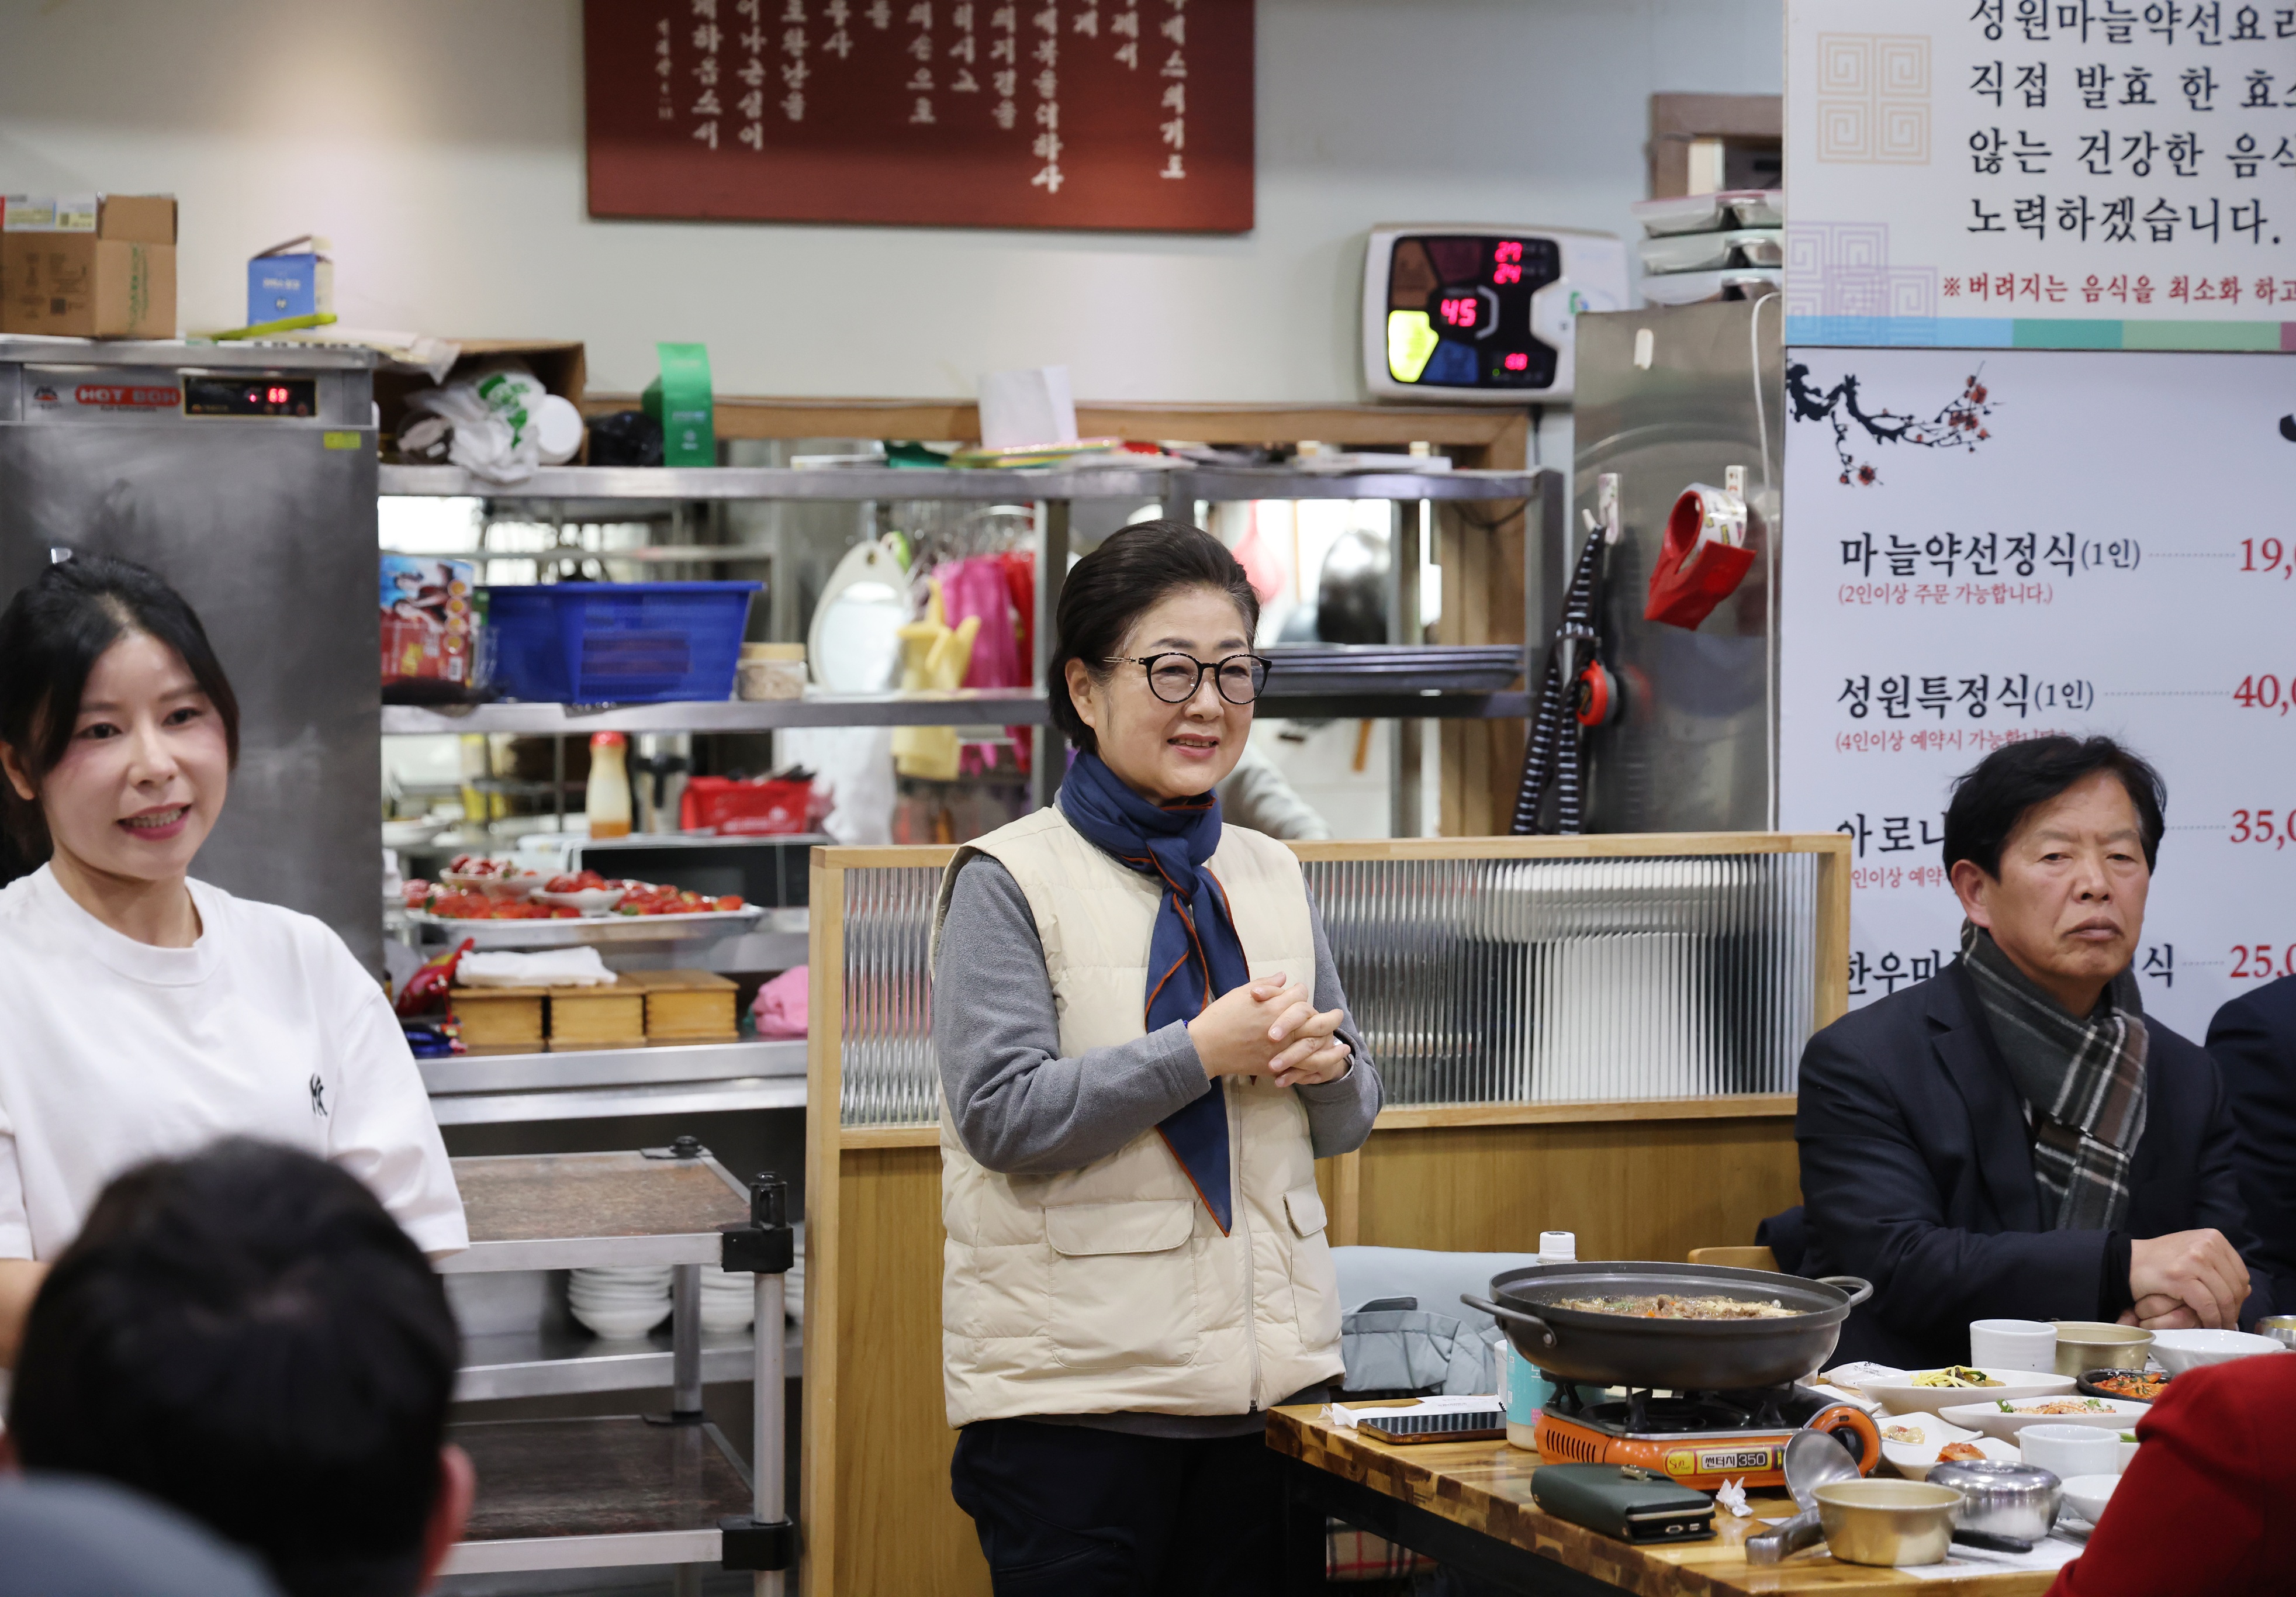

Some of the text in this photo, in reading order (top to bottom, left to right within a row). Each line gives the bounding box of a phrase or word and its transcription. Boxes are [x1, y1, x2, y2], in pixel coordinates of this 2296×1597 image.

[1970, 60, 2047, 108] 직접
[2076, 63, 2157, 109] 발효
[2180, 66, 2220, 111] 한
[1969, 127, 2053, 174] 않는
[2077, 129, 2204, 177] 건강한
[1967, 194, 2281, 244] 노력하겠습니다.
[2081, 274, 2156, 304] 음식을
[2169, 275, 2243, 305] 최소화
[2254, 276, 2296, 306] 하고
[1440, 298, 1477, 327] 45
[2239, 537, 2296, 580] 19,
[1838, 582, 1908, 605] (2인이상
[1914, 583, 1951, 605] 주문
[2233, 674, 2296, 717] 40,
[1910, 729, 1963, 752] 예약시
[1851, 865, 1948, 889] 인이상 예약
[1848, 949, 1958, 995] 한우마
[2141, 942, 2174, 988] 식
[1738, 1453, 1766, 1467] 350
